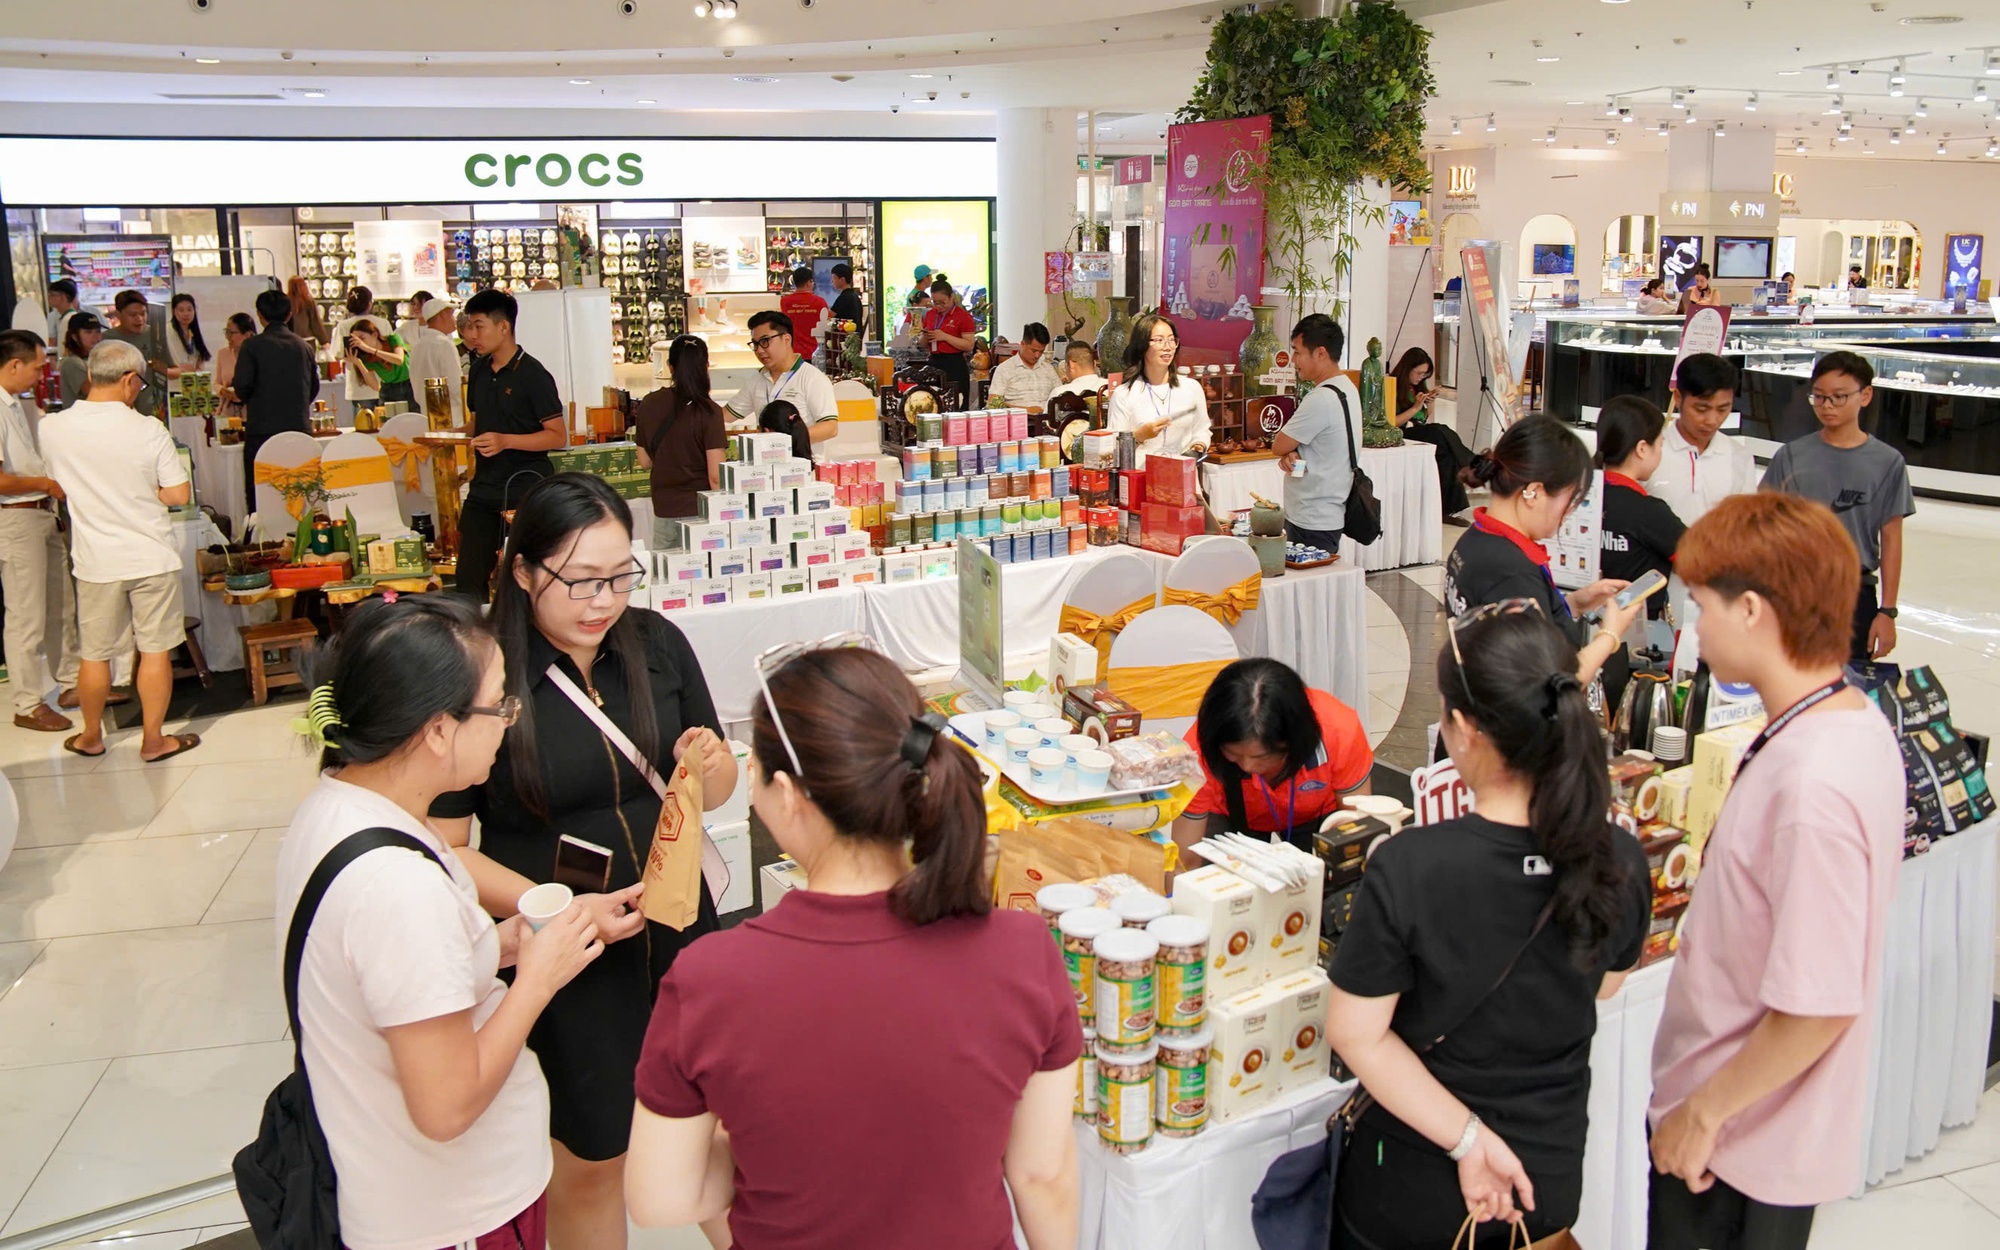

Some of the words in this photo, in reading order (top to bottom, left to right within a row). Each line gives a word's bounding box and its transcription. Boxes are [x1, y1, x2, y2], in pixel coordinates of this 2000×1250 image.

[464, 152, 644, 188] crocs
[1682, 202, 1697, 217] PNJ
[1745, 203, 1765, 219] PNJ
[1838, 489, 1868, 505] NIKE
[1710, 705, 1748, 724] INTIMEX
